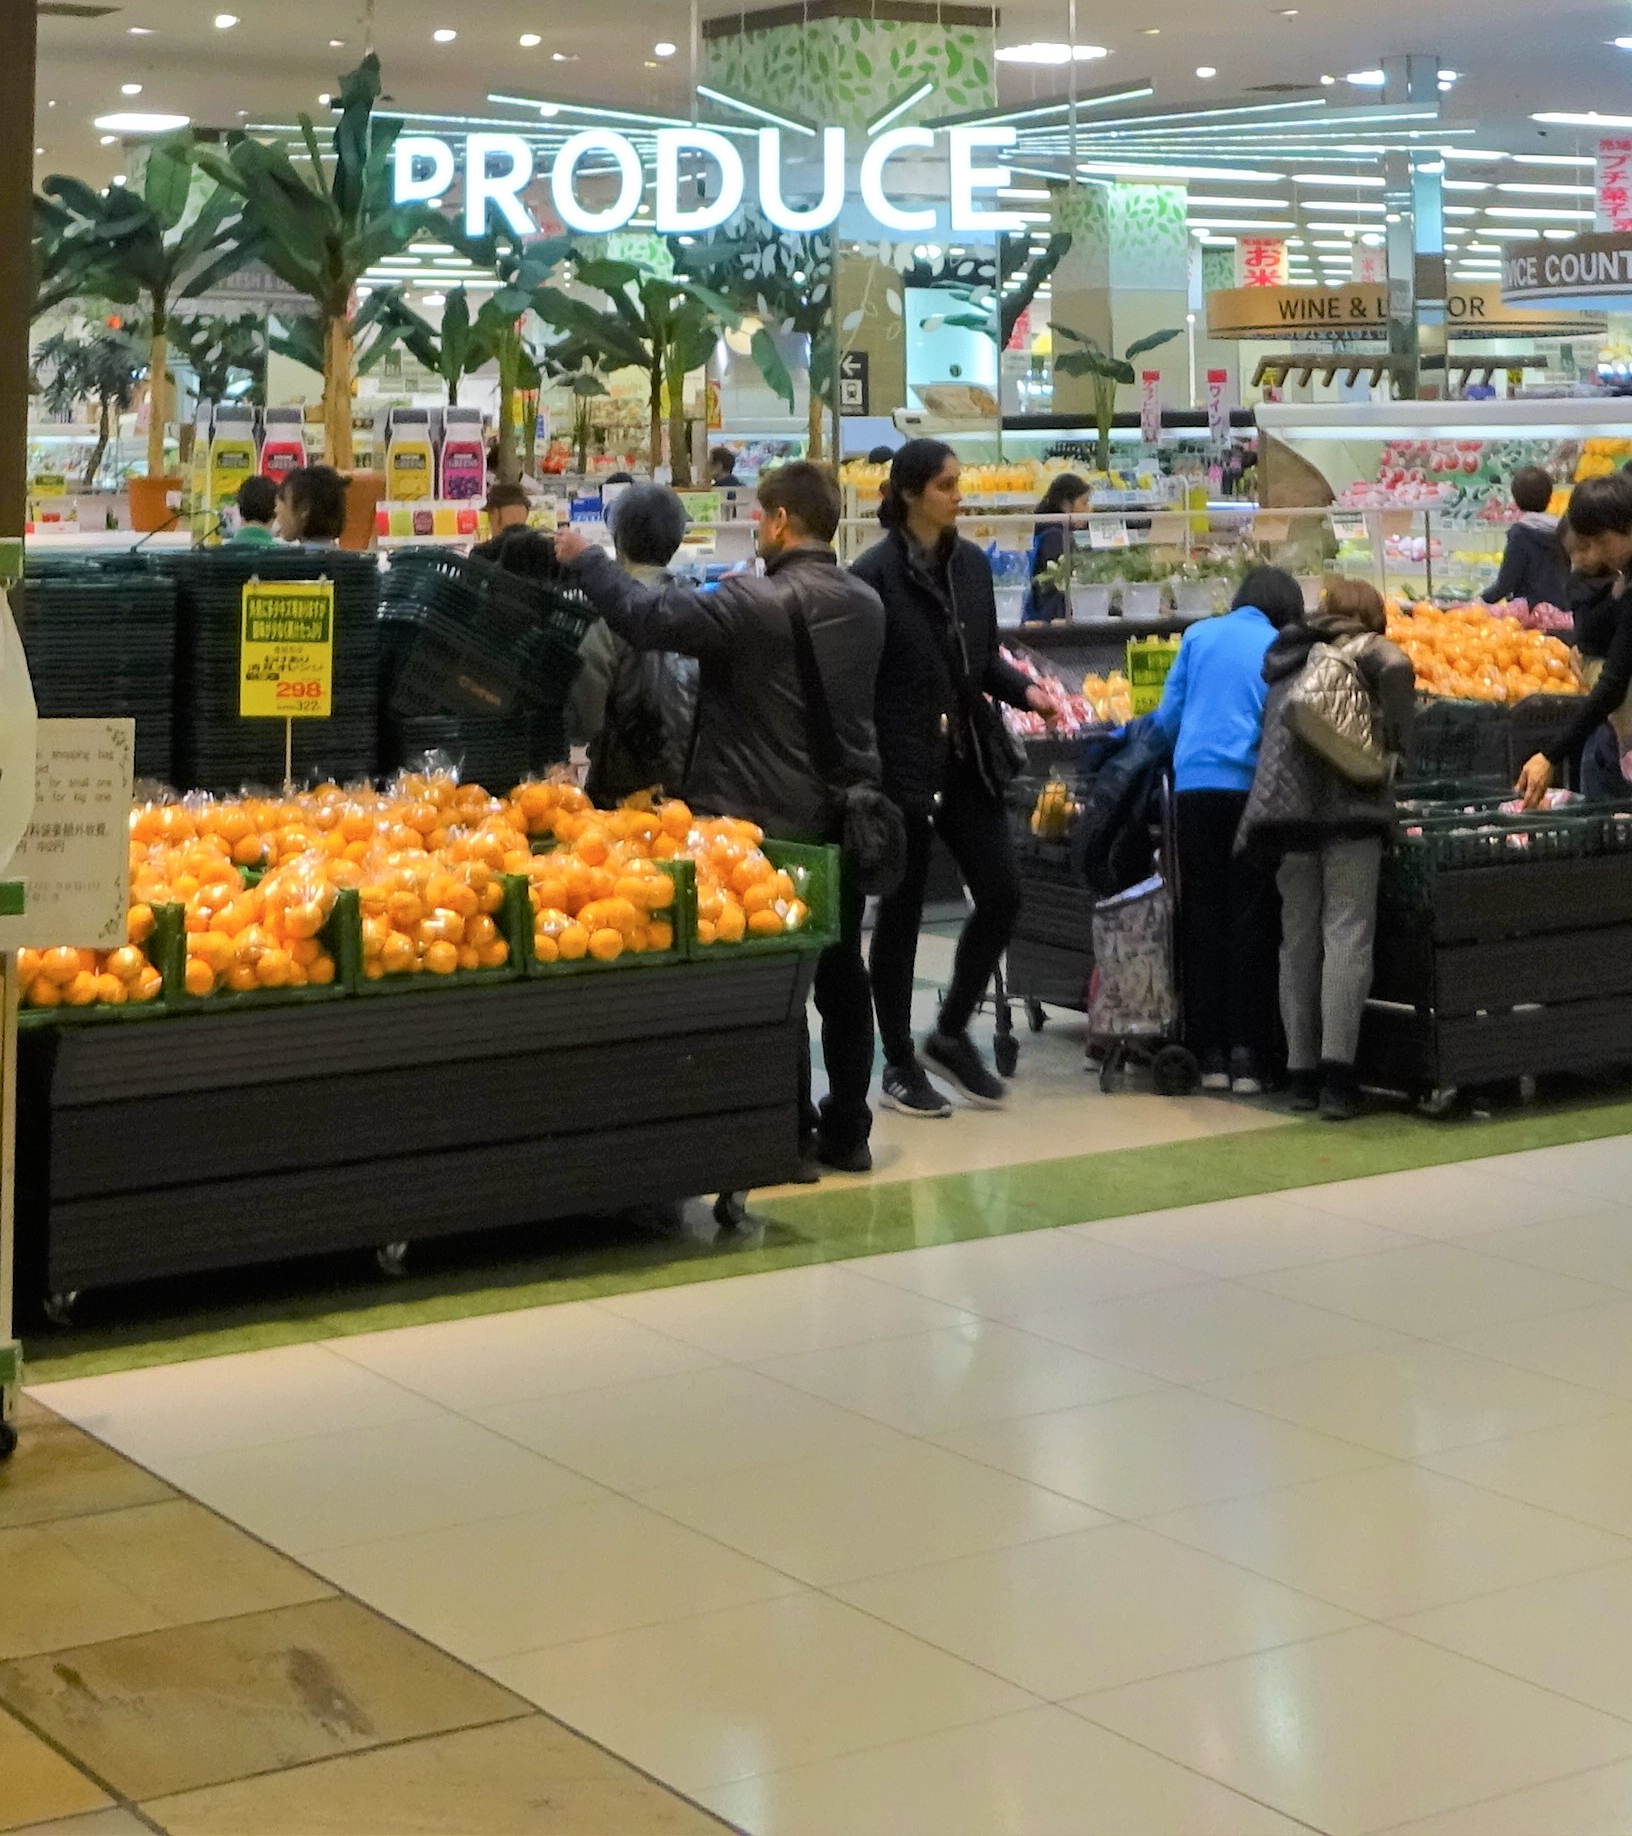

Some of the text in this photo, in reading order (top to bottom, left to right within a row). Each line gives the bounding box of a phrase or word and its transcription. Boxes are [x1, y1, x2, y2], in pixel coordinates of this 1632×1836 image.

[393, 126, 1018, 238] PRODUCE
[1243, 246, 1283, 287] お米
[1278, 296, 1341, 320] WINE
[1350, 297, 1369, 318] &
[276, 681, 322, 698] 298
